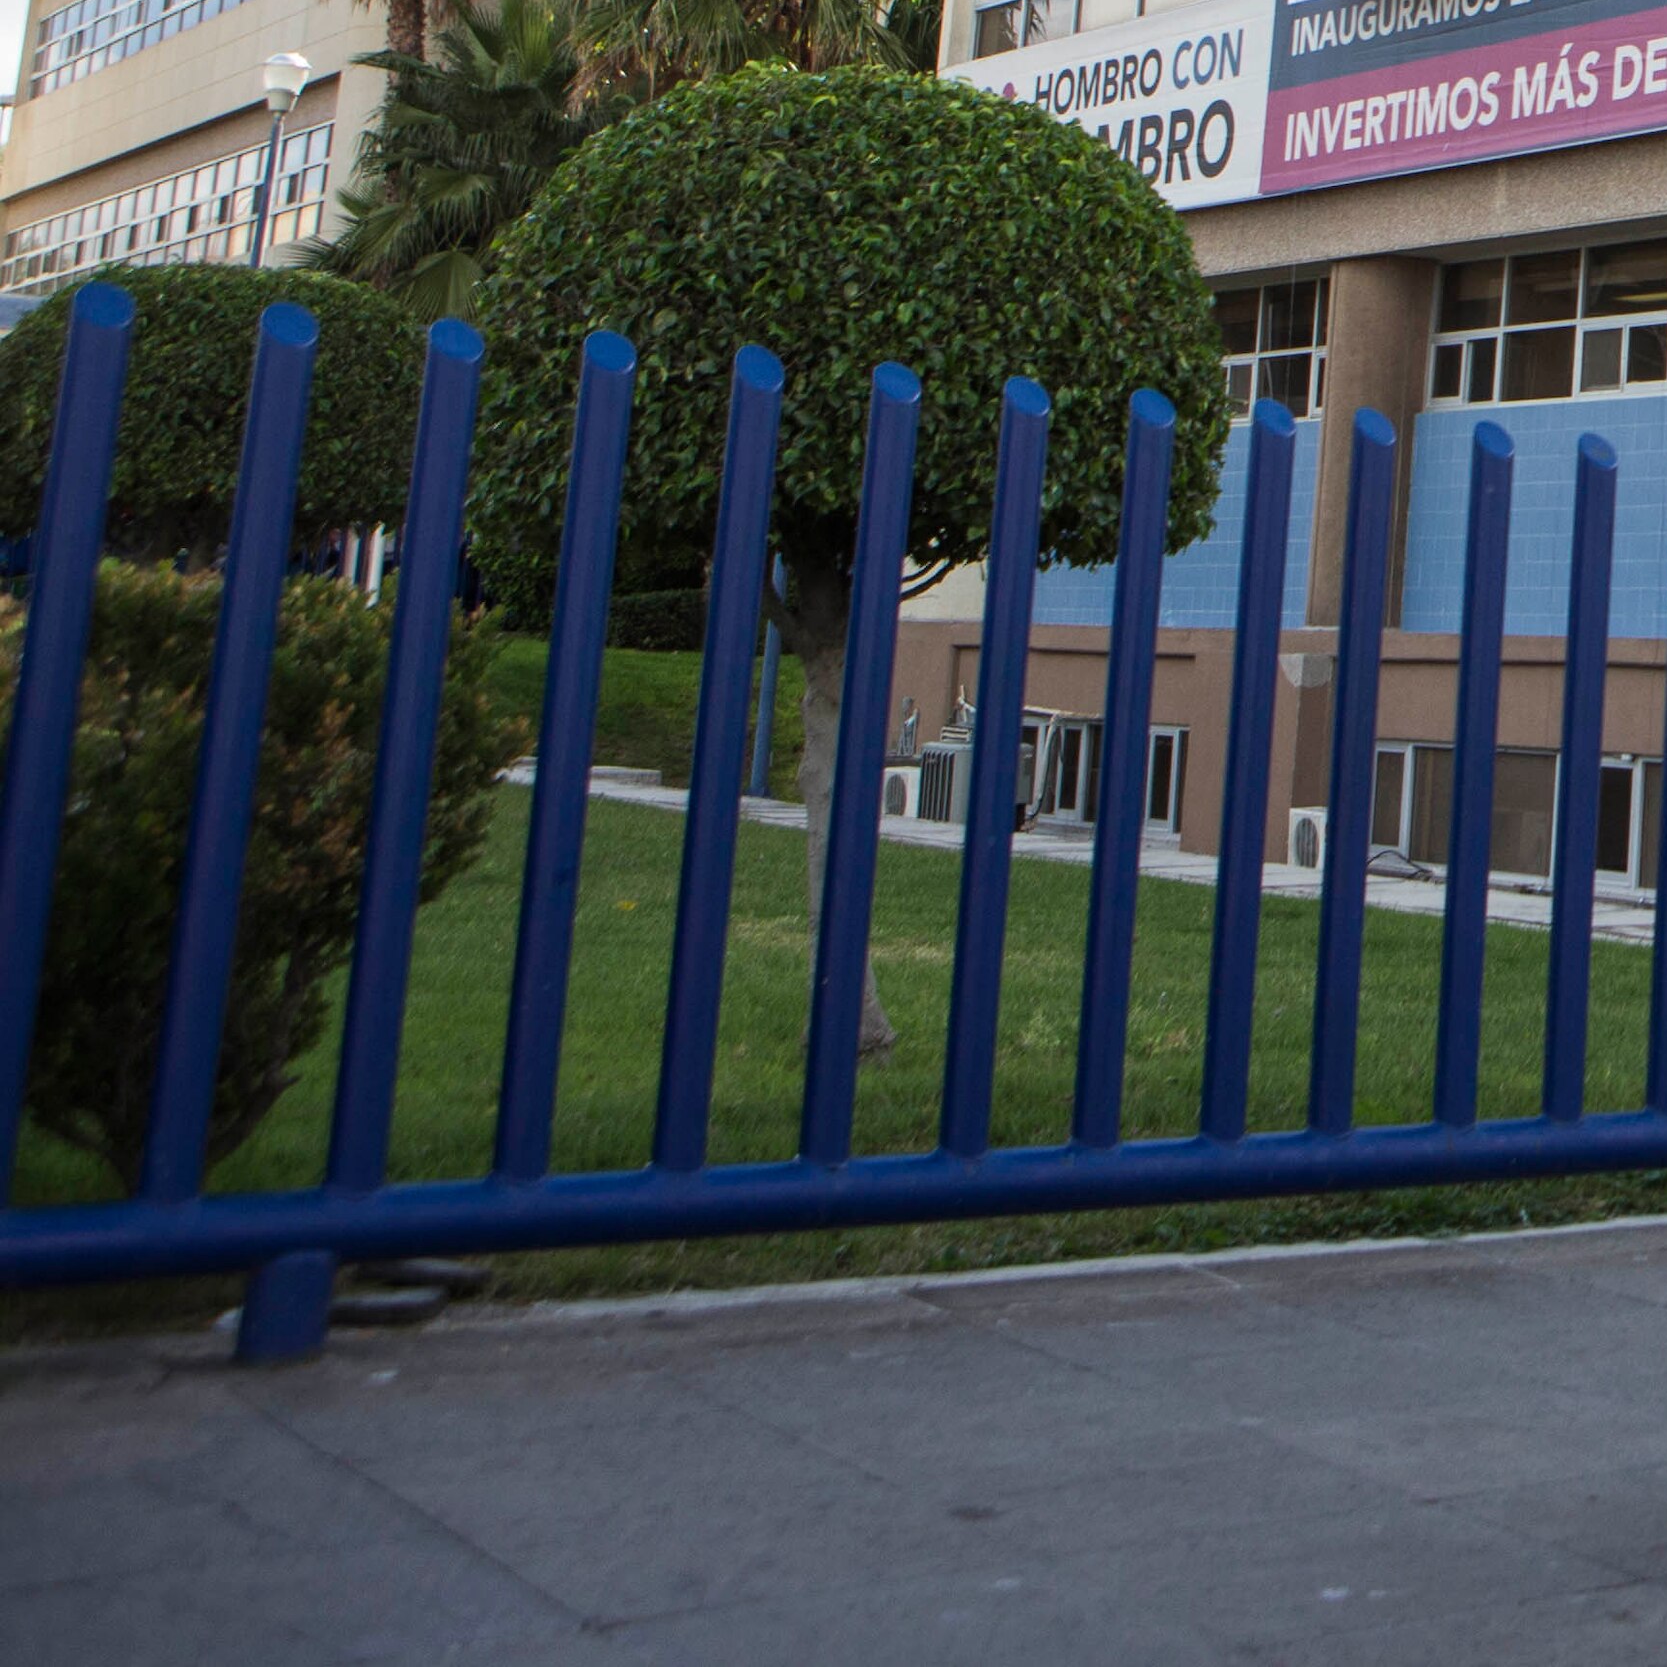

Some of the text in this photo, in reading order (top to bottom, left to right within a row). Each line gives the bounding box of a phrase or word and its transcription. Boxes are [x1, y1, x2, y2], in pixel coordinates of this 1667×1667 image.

[1034, 28, 1244, 115] HOMBRO CON
[1283, 71, 1500, 162] INVERTIMOS
[1511, 43, 1600, 120] MÁS
